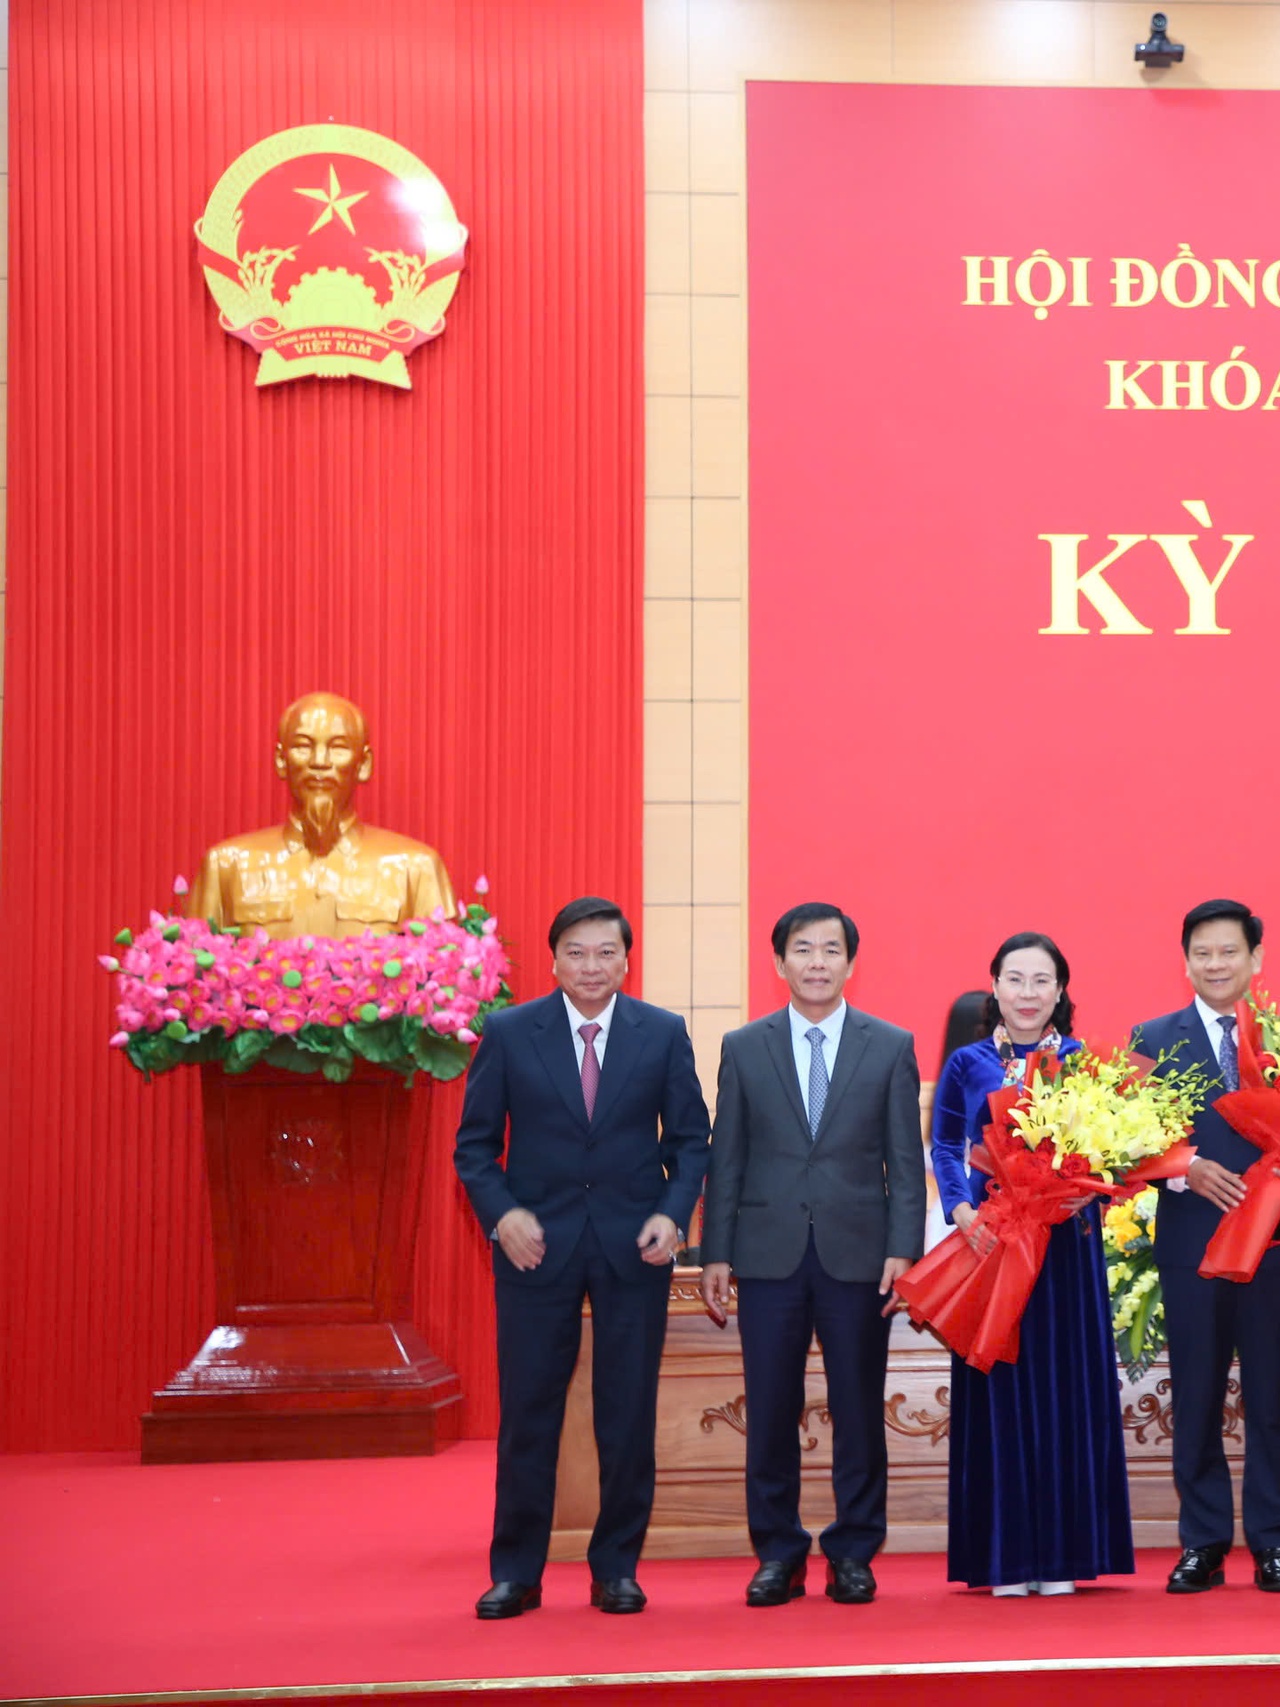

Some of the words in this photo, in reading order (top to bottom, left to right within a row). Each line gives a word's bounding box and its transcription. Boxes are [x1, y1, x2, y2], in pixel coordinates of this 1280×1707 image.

[962, 249, 1092, 320] HỘI
[294, 340, 332, 355] VIỆT
[336, 340, 372, 356] NAM
[1038, 500, 1254, 636] KỲ
